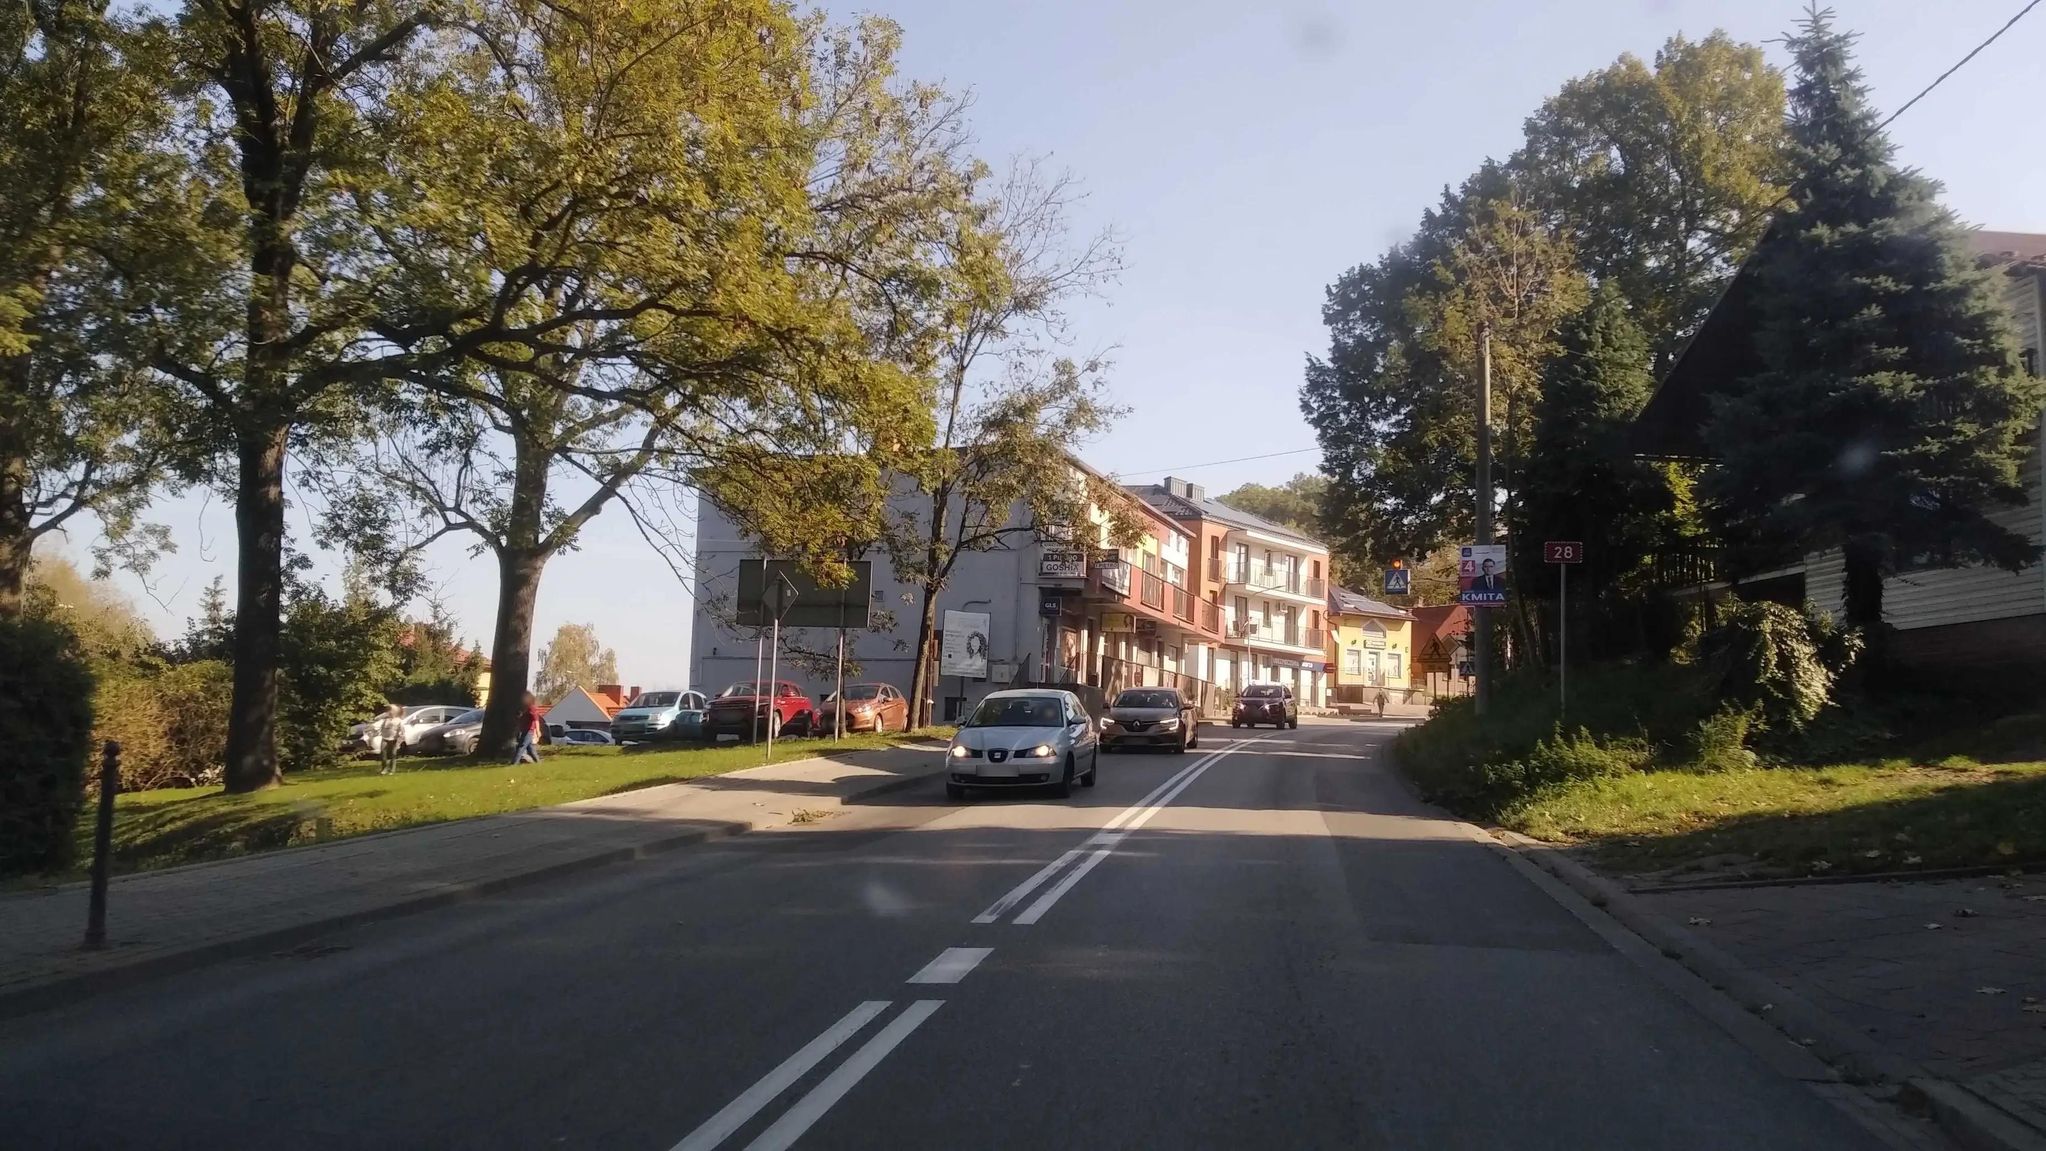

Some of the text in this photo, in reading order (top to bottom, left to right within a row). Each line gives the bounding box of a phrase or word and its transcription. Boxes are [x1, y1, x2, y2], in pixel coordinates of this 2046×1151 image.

[1554, 546, 1573, 559] 28
[1464, 560, 1474, 572] 4
[1462, 592, 1505, 601] KMITA
